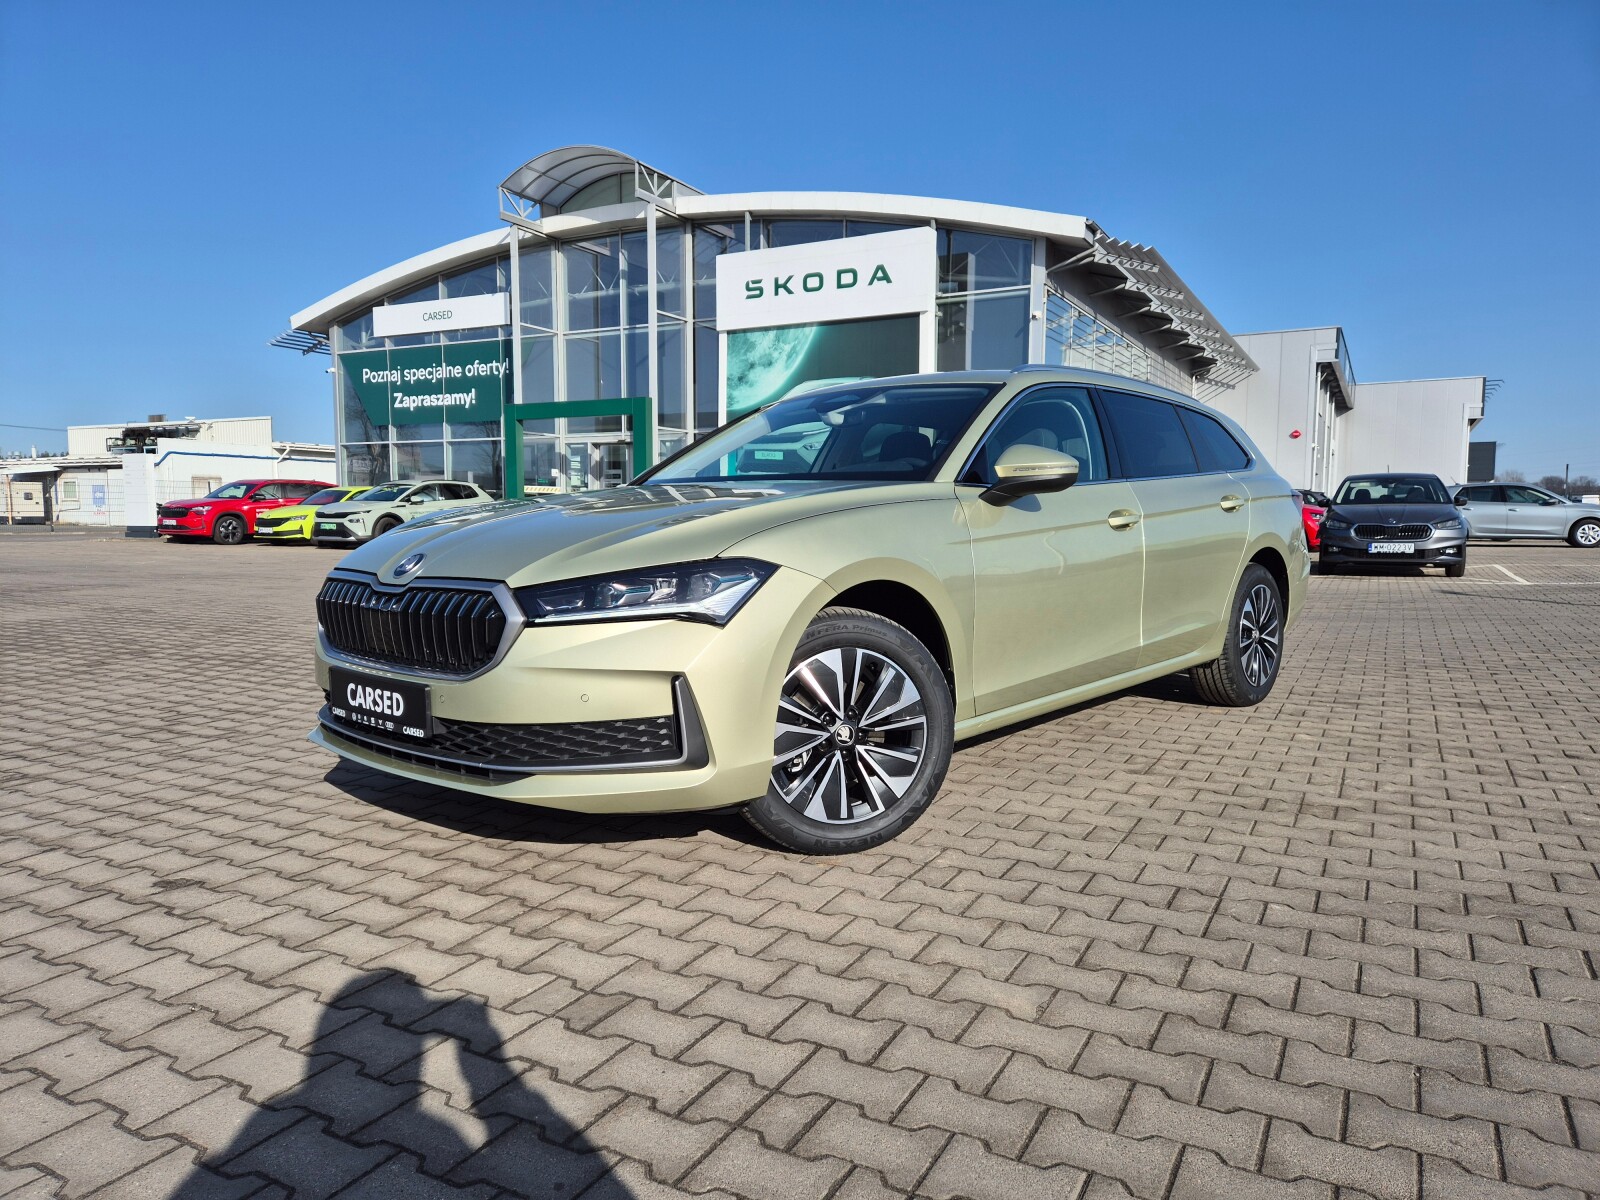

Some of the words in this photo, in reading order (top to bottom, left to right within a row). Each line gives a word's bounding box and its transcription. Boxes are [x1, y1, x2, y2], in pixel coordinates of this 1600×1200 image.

[745, 264, 892, 299] SKODA
[422, 310, 453, 322] CARSED
[362, 366, 401, 385] Poznaj
[403, 362, 462, 384] specjalne
[465, 357, 509, 379] oferty!
[393, 388, 476, 411] Zapraszamy!
[852, 624, 888, 637] Primus
[347, 683, 404, 716] CARSED
[332, 706, 346, 718] CARSED
[402, 726, 424, 738] CARSED
[813, 832, 883, 848] NEXEN
